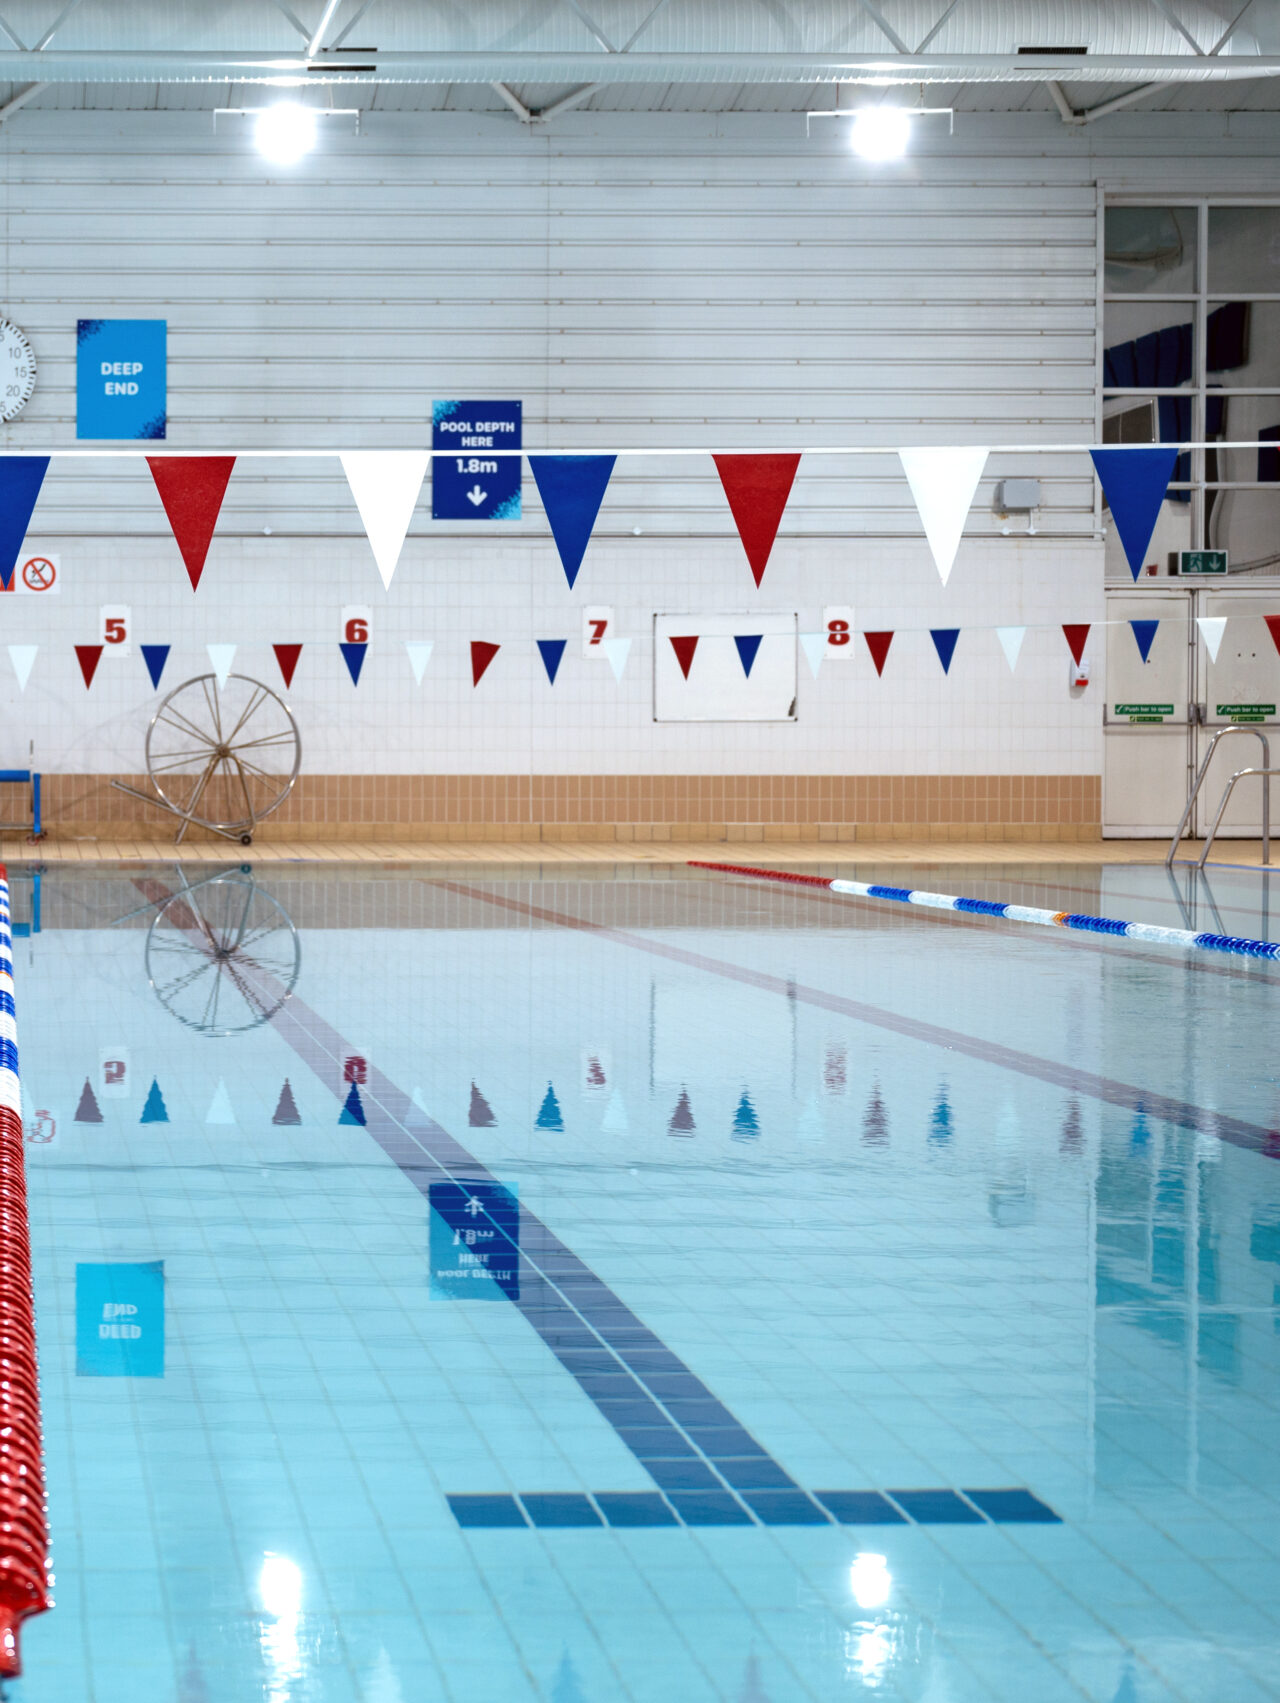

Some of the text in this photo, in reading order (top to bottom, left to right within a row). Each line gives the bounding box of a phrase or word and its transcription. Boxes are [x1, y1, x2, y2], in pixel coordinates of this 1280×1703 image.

[9, 347, 22, 359] 10
[14, 366, 28, 378] 15
[100, 362, 144, 376] DEEP
[6, 384, 20, 397] 20
[104, 382, 139, 396] END
[440, 422, 516, 433] POOL DEPTH
[461, 436, 494, 447] HERE
[456, 458, 498, 474] 1.8m
[104, 618, 126, 644] 5
[345, 618, 368, 643] 6
[579, 620, 598, 645] 7
[827, 619, 850, 646] 8
